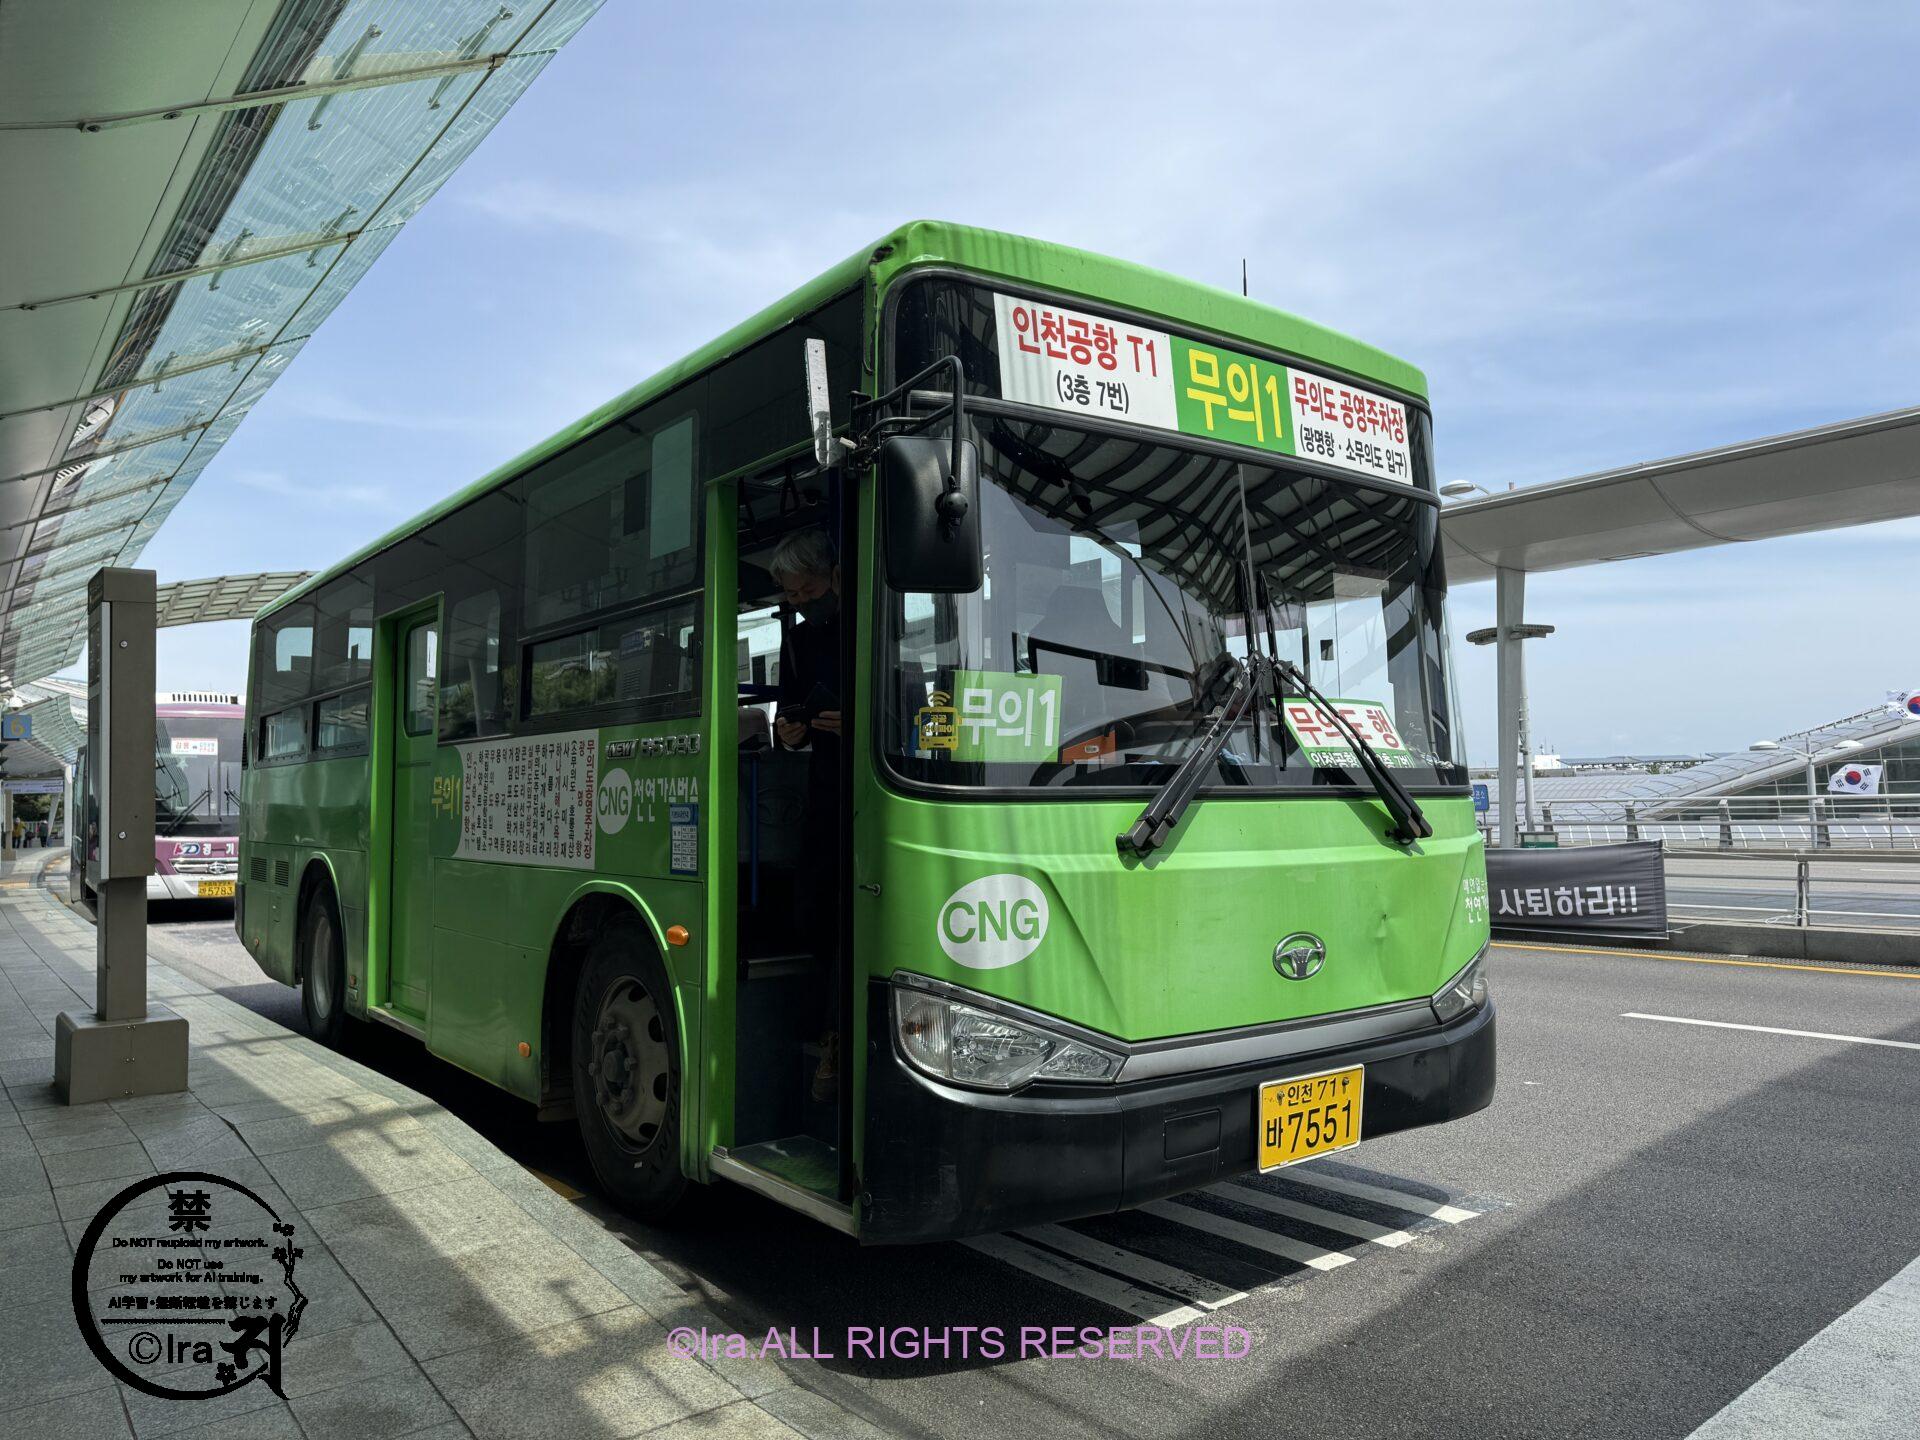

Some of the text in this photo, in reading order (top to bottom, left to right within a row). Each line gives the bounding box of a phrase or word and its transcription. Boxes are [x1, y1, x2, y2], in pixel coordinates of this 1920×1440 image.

[1012, 306, 1158, 378] 인천공항 T1
[1056, 369, 1130, 414] (3층 7번)
[1186, 347, 1283, 443] 무의1
[1294, 376, 1405, 444] 무의도 공영주차장
[1299, 423, 1335, 458] (광명항
[1345, 437, 1384, 469] 소무의도
[1385, 448, 1408, 478] 입구)
[961, 687, 1056, 747] 무의1
[608, 741, 633, 757] NEW
[431, 774, 462, 820] 무의1
[598, 786, 630, 817] CNG
[634, 776, 699, 823] 천연가스버스
[942, 898, 1040, 944] CNG
[1498, 885, 1638, 917] 사퇴하라!!
[1287, 1077, 1337, 1106] 인천 71
